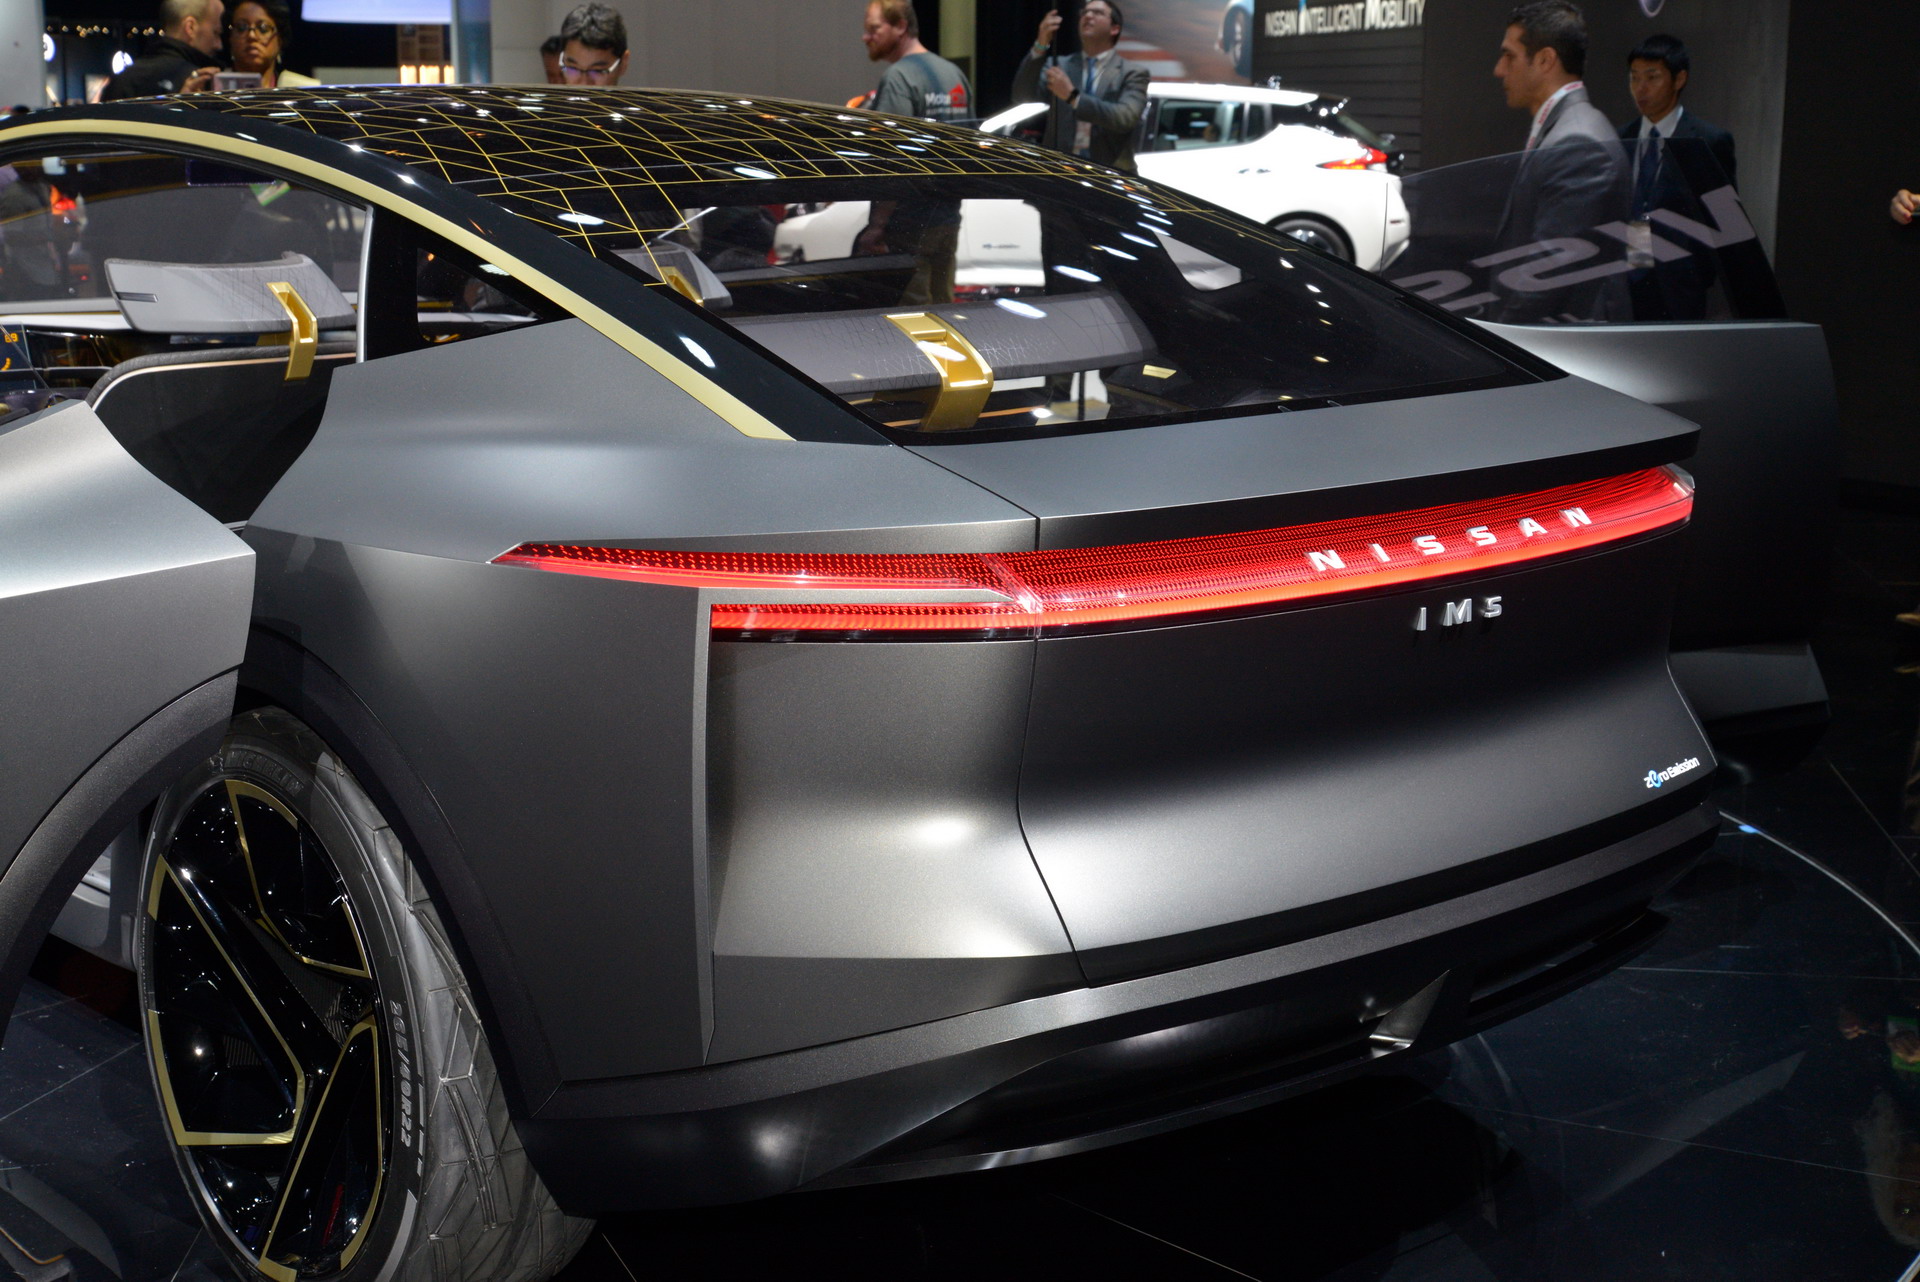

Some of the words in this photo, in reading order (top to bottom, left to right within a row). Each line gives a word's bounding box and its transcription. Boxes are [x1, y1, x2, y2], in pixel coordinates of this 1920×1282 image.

[1264, 10, 1298, 37] NISSAN
[1298, 1, 1365, 35] INTELLIGENT
[1364, 0, 1426, 30] MOBILITY
[1307, 507, 1592, 572] NISSAN
